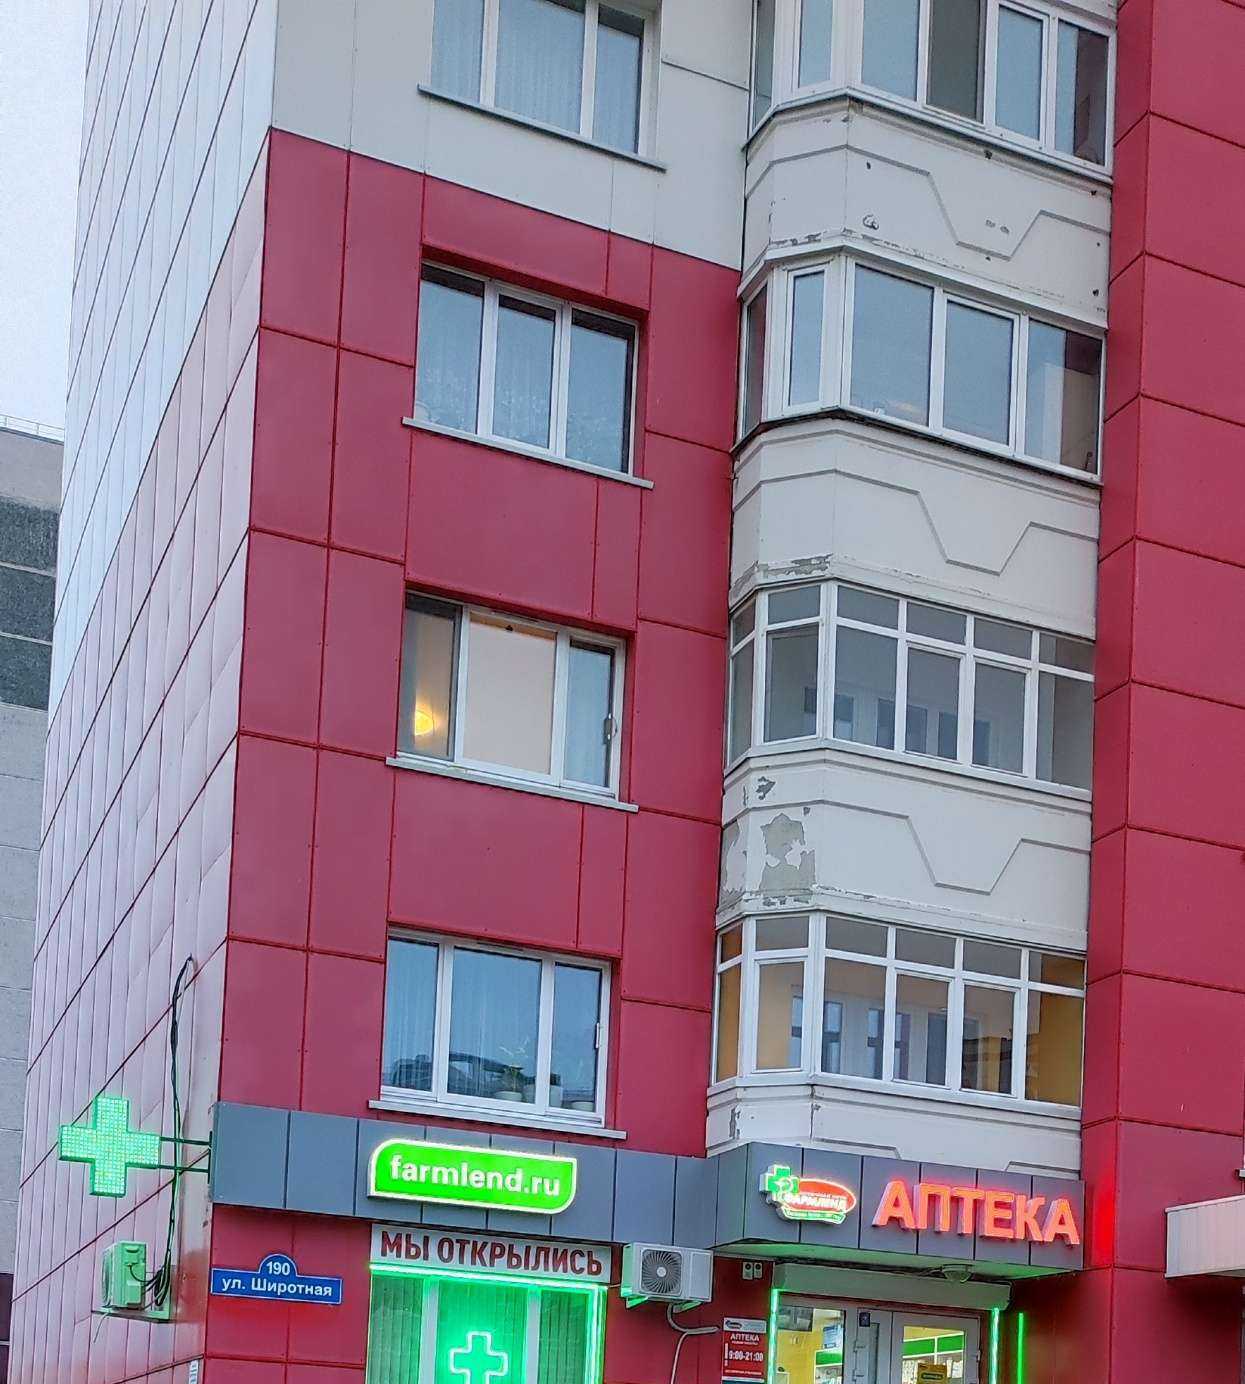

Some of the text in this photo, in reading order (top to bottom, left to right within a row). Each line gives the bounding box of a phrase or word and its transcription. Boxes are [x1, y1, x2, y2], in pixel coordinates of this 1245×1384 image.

[391, 1155, 560, 1196] farmlend.ru
[872, 1180, 1080, 1245] АПТЕКА
[381, 1230, 602, 1276] МЫ ОТКРЫЛИСЬ
[266, 1261, 291, 1276] 190
[222, 1278, 332, 1296] ул. Широтная
[730, 1333, 760, 1342] АПТЕКА
